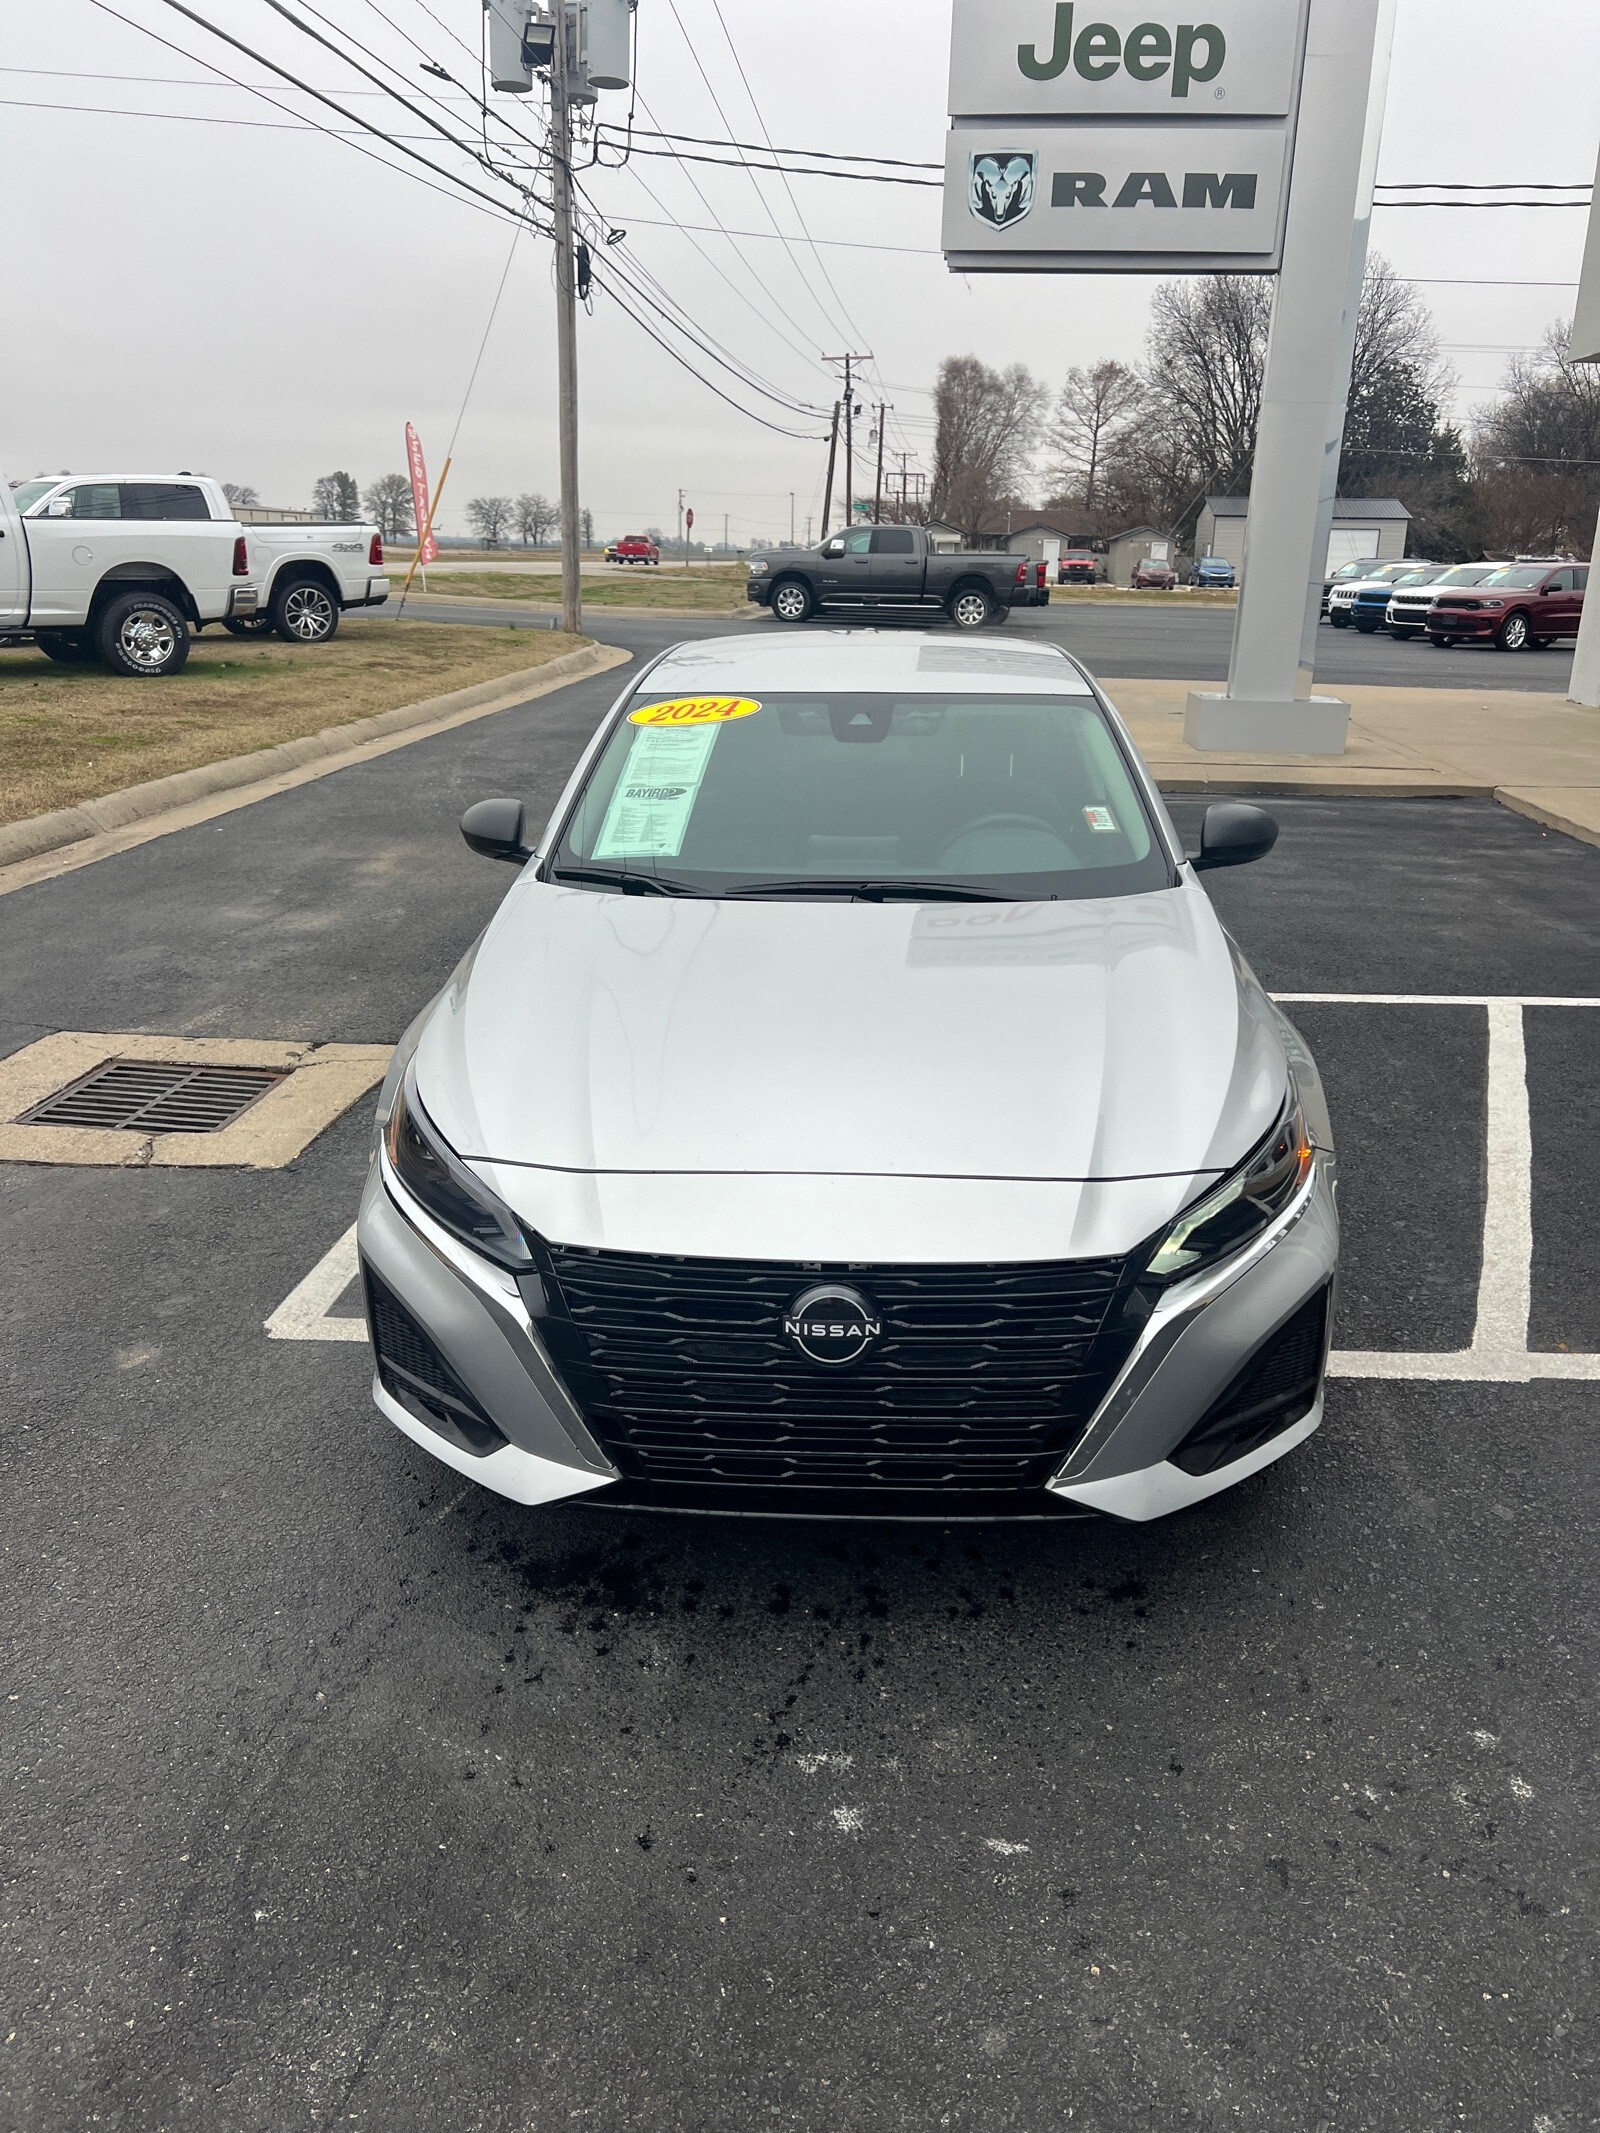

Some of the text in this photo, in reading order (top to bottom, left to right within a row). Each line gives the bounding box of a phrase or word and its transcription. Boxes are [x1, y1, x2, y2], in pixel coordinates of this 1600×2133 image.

[1017, 2, 1227, 97] Jeep
[1051, 172, 1257, 209] RAM
[648, 700, 739, 723] 2024
[784, 1321, 881, 1337] NISSAN
